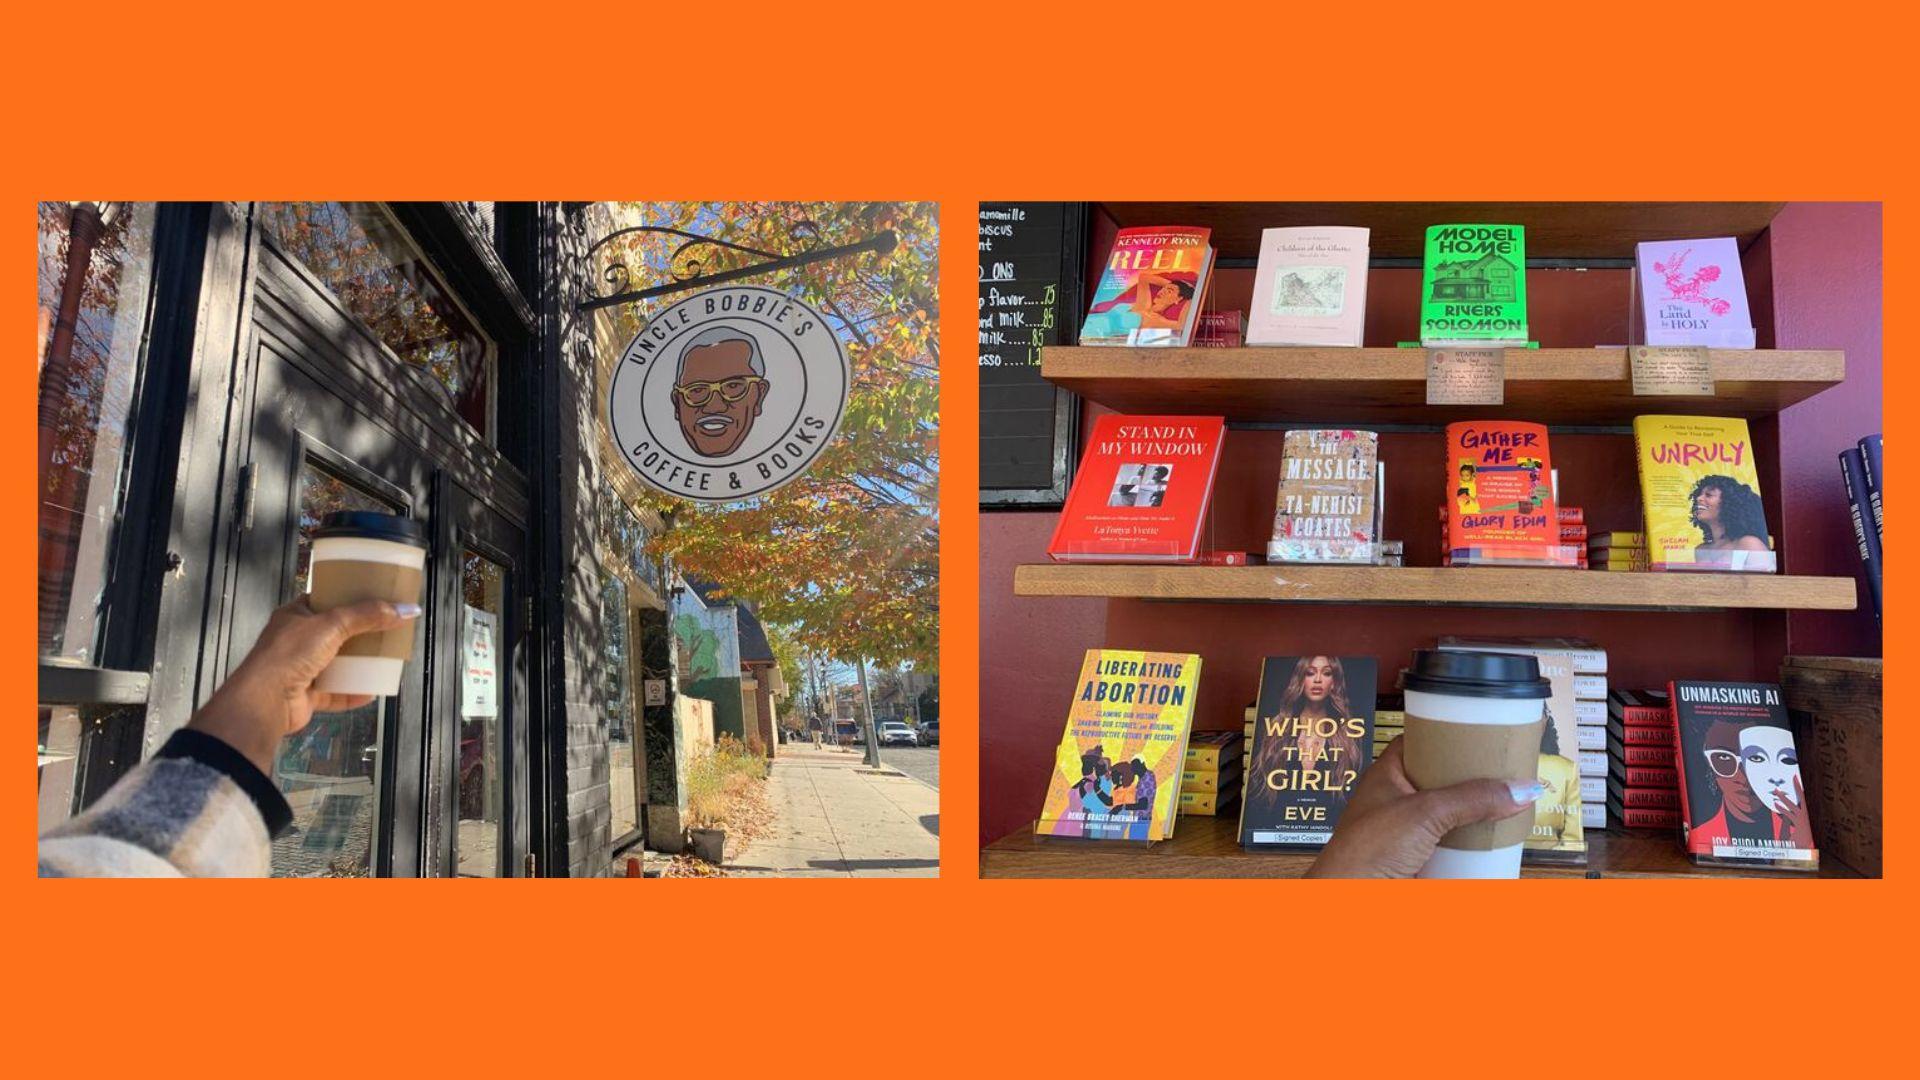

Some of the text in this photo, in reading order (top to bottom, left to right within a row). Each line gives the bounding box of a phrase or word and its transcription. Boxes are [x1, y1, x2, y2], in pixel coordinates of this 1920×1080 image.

[1118, 237, 1199, 246] KENNEDY RYAN
[1432, 228, 1517, 240] MODEL
[1439, 241, 1511, 254] HOME
[1111, 249, 1190, 270] REEL
[1444, 305, 1503, 317] RIVERS
[1660, 309, 1691, 319] Land
[629, 294, 814, 366] UNCLE BOBBIE'S
[1426, 319, 1522, 331] SOLOMON
[1671, 319, 1709, 330] HOLY
[1117, 426, 1197, 439] STAND IN
[1460, 428, 1539, 448] GATHER
[633, 416, 825, 490] COFFEE & BOOKS
[1097, 442, 1207, 456] MY WINDOW
[1319, 442, 1338, 455] THE
[1483, 447, 1513, 464] ME
[1651, 440, 1745, 466] UNRULY
[1286, 458, 1369, 480] MESSAGE
[1286, 495, 1364, 515] TA-NEHISI
[1294, 517, 1352, 537] COATES
[1461, 515, 1547, 529] GLORY EDIM
[1096, 660, 1183, 679] LIBERATING
[1081, 681, 1186, 706] ABORTION
[1680, 686, 1779, 706] UNMASKING AI
[1264, 716, 1366, 738] WHO'S
[1282, 746, 1345, 762] THAT
[1266, 769, 1358, 792] GIRL?
[1284, 806, 1327, 821] EVE
[1278, 834, 1324, 842] Signed Copies
[1738, 848, 1786, 857] Signed Copies
